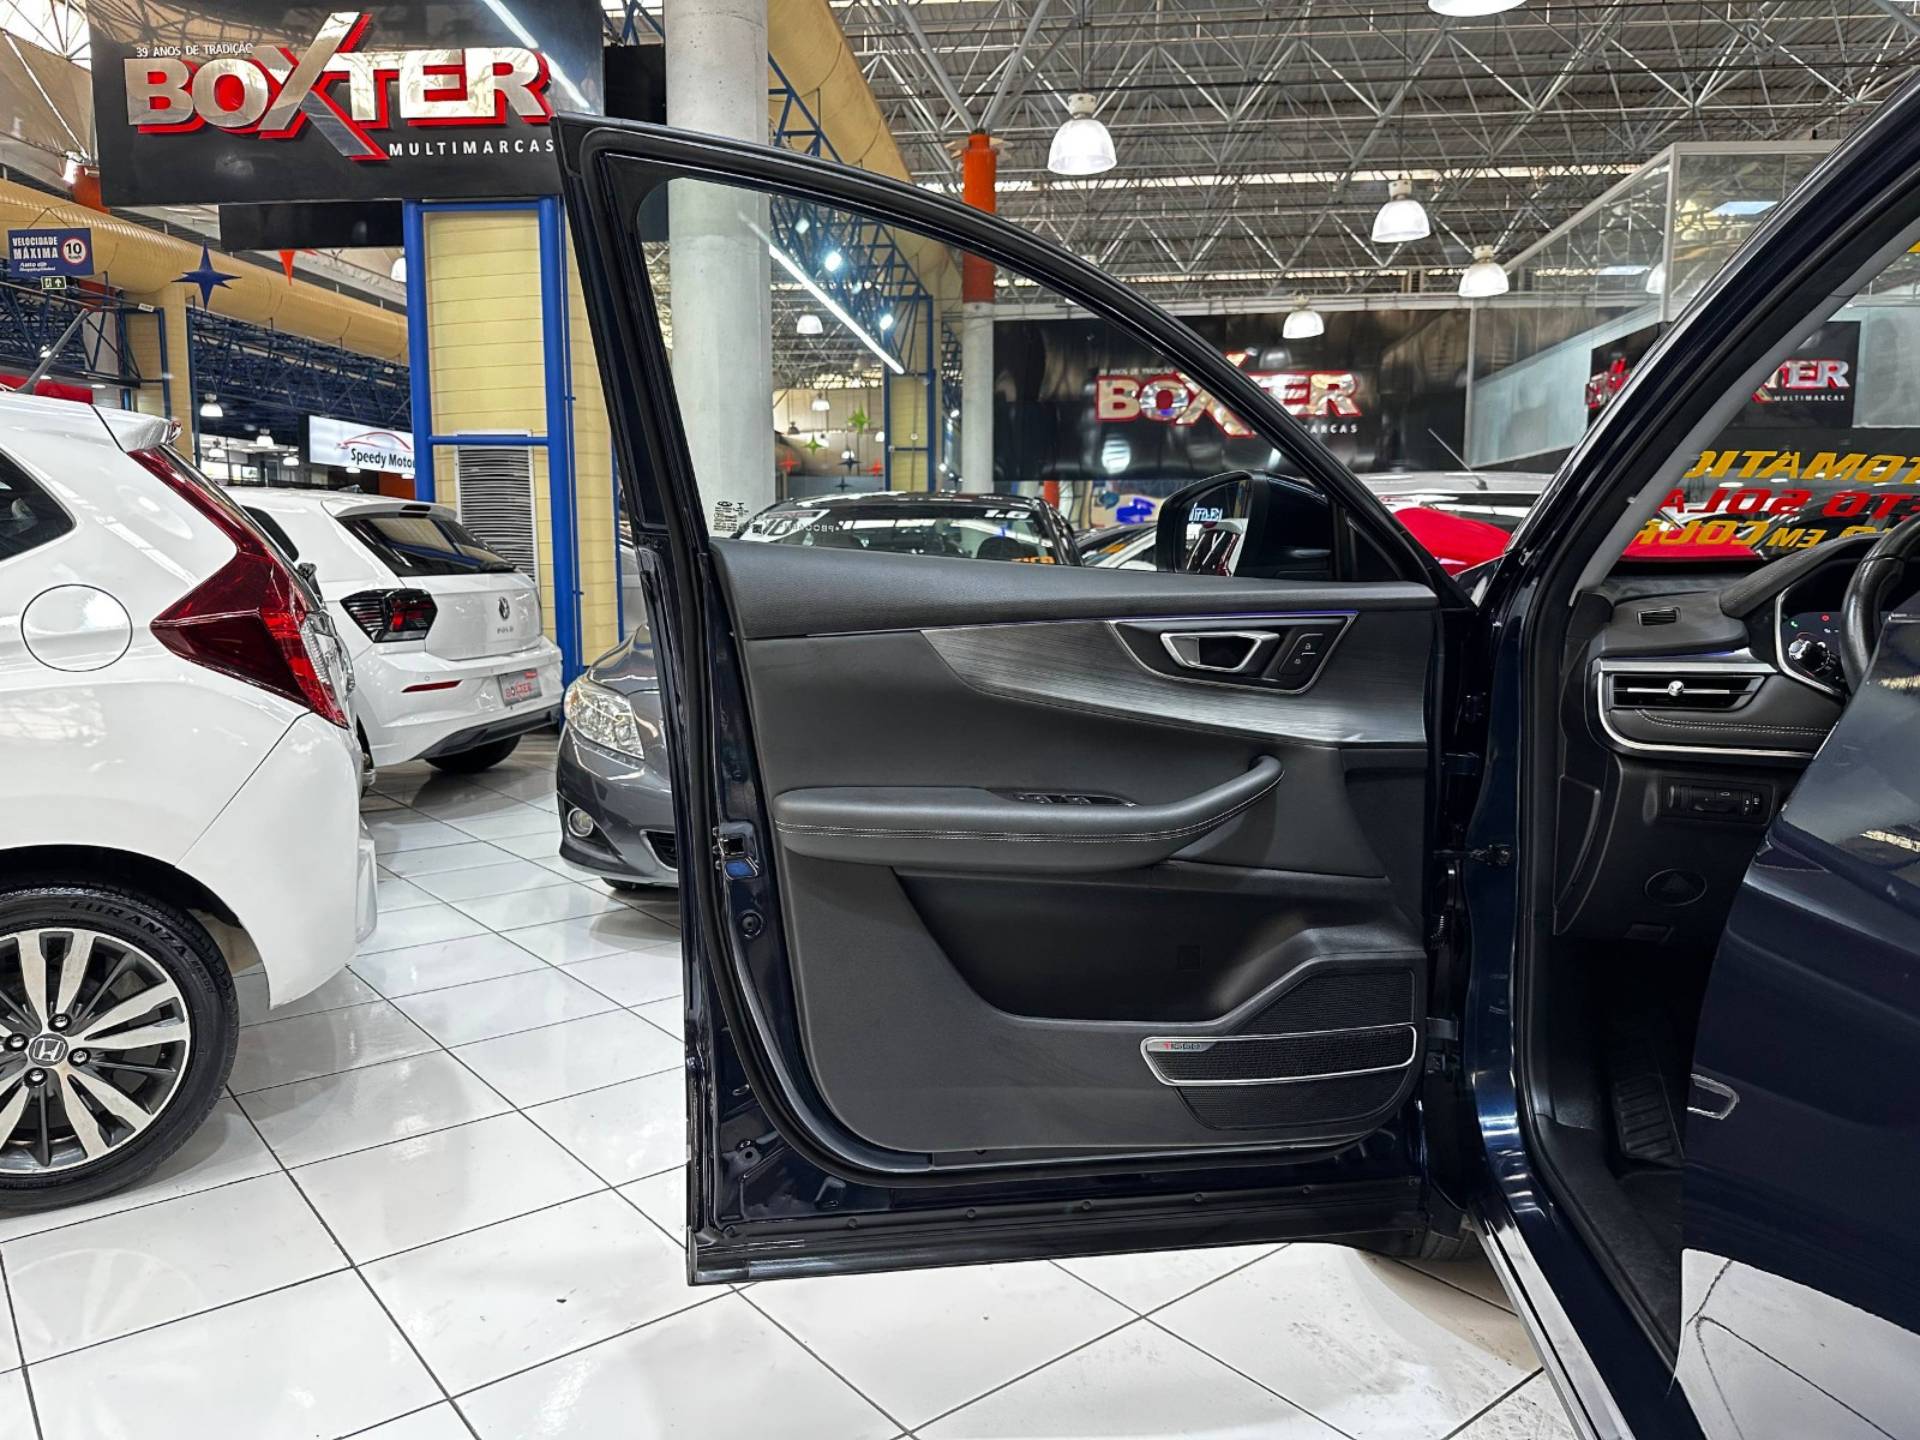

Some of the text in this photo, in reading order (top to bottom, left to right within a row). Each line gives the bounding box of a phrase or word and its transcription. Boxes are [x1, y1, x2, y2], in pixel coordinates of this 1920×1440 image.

[136, 46, 149, 57] 39
[153, 45, 181, 57] ANOS
[185, 44, 200, 55] DE
[124, 12, 553, 160] BOXTER
[389, 139, 555, 157] MULTIMARCAS
[12, 236, 58, 246] VELOCIDADE
[13, 246, 58, 259] MÁXIMA
[65, 243, 81, 254] 10
[1304, 424, 1358, 434] ARCAS
[351, 448, 387, 468] Speedy
